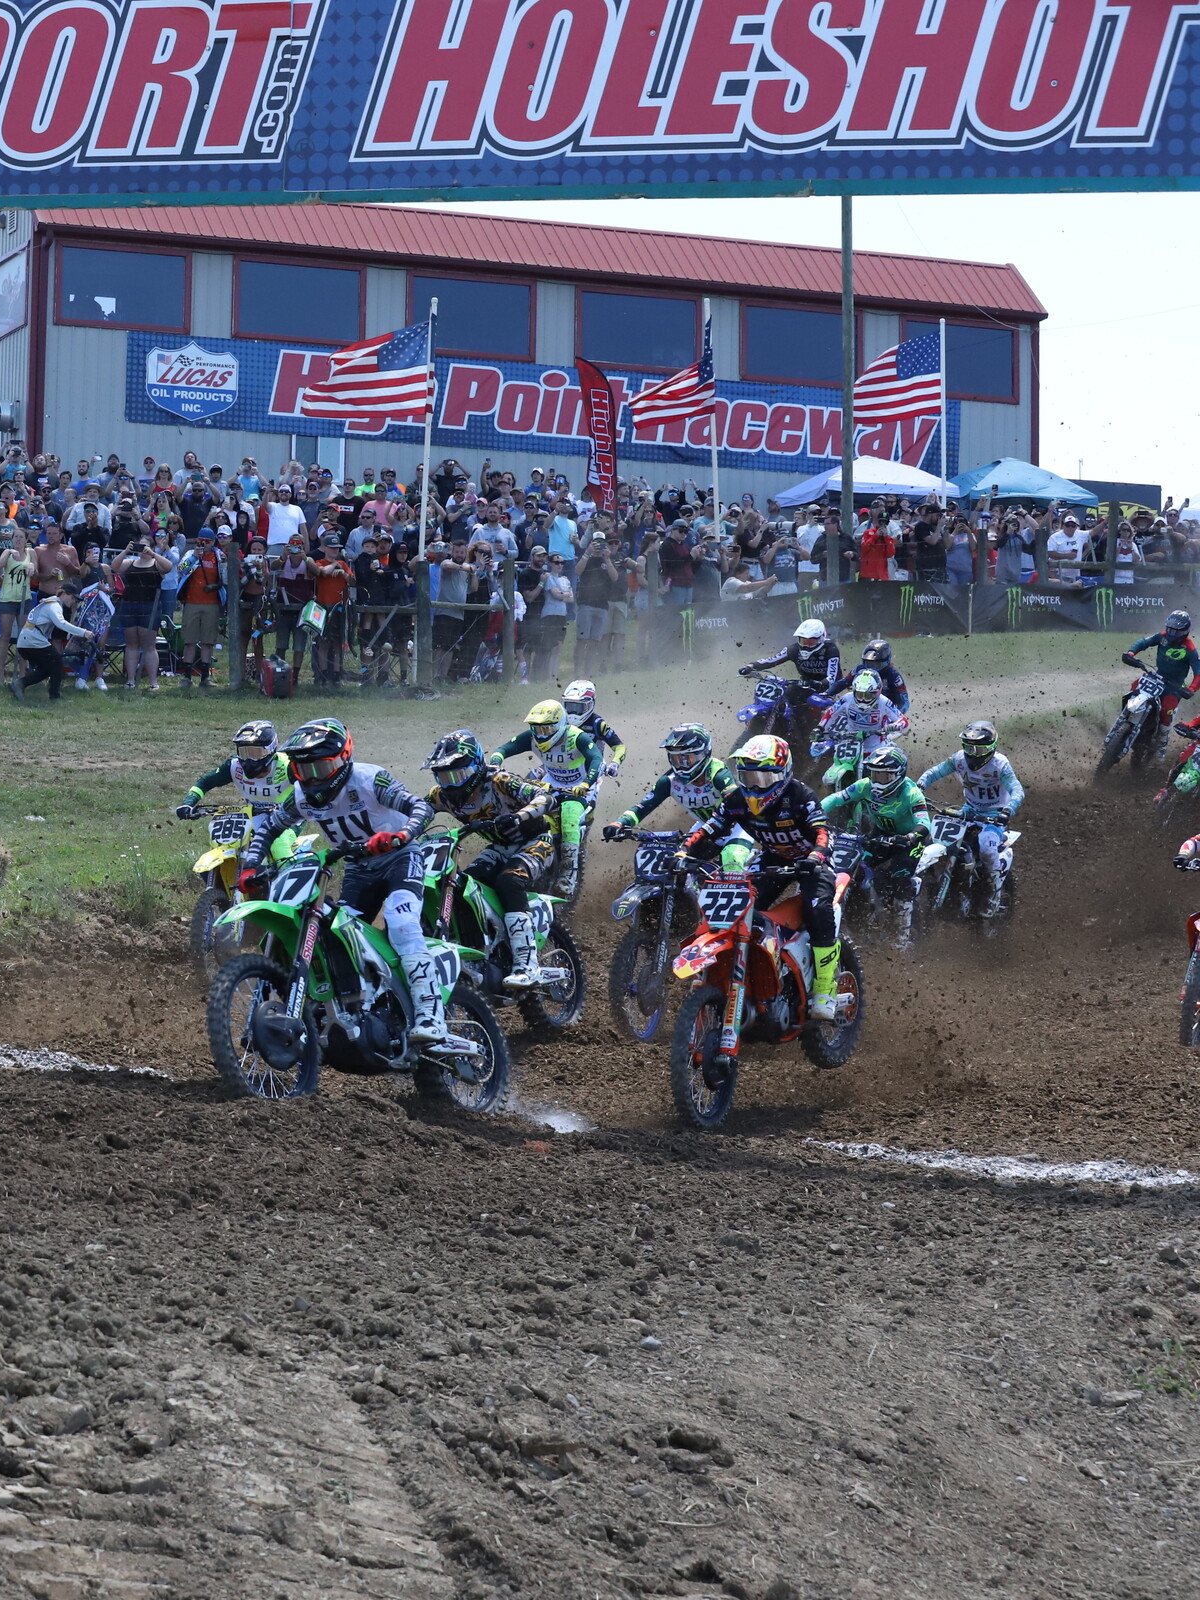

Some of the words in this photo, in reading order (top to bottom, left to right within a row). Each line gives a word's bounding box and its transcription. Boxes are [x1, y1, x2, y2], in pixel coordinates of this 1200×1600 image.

[196, 361, 236, 369] PERFORMANCE
[156, 366, 234, 388] LUCAS
[151, 388, 170, 398] OIL
[173, 390, 233, 402] PRODUCTS
[181, 403, 204, 413] INC.
[630, 376, 942, 470] aceway
[1022, 594, 1061, 606] MONSTER
[1115, 596, 1165, 608] MONSTER
[836, 742, 858, 759] 65
[978, 784, 1001, 800] FLY
[211, 819, 247, 841] 285
[318, 809, 377, 843] FLY
[934, 821, 962, 843] 12
[272, 866, 320, 905] 17
[395, 902, 412, 914] FLY
[701, 891, 751, 922] 222
[302, 923, 318, 961] SHOWA
[293, 976, 306, 1019] DUNLOP
